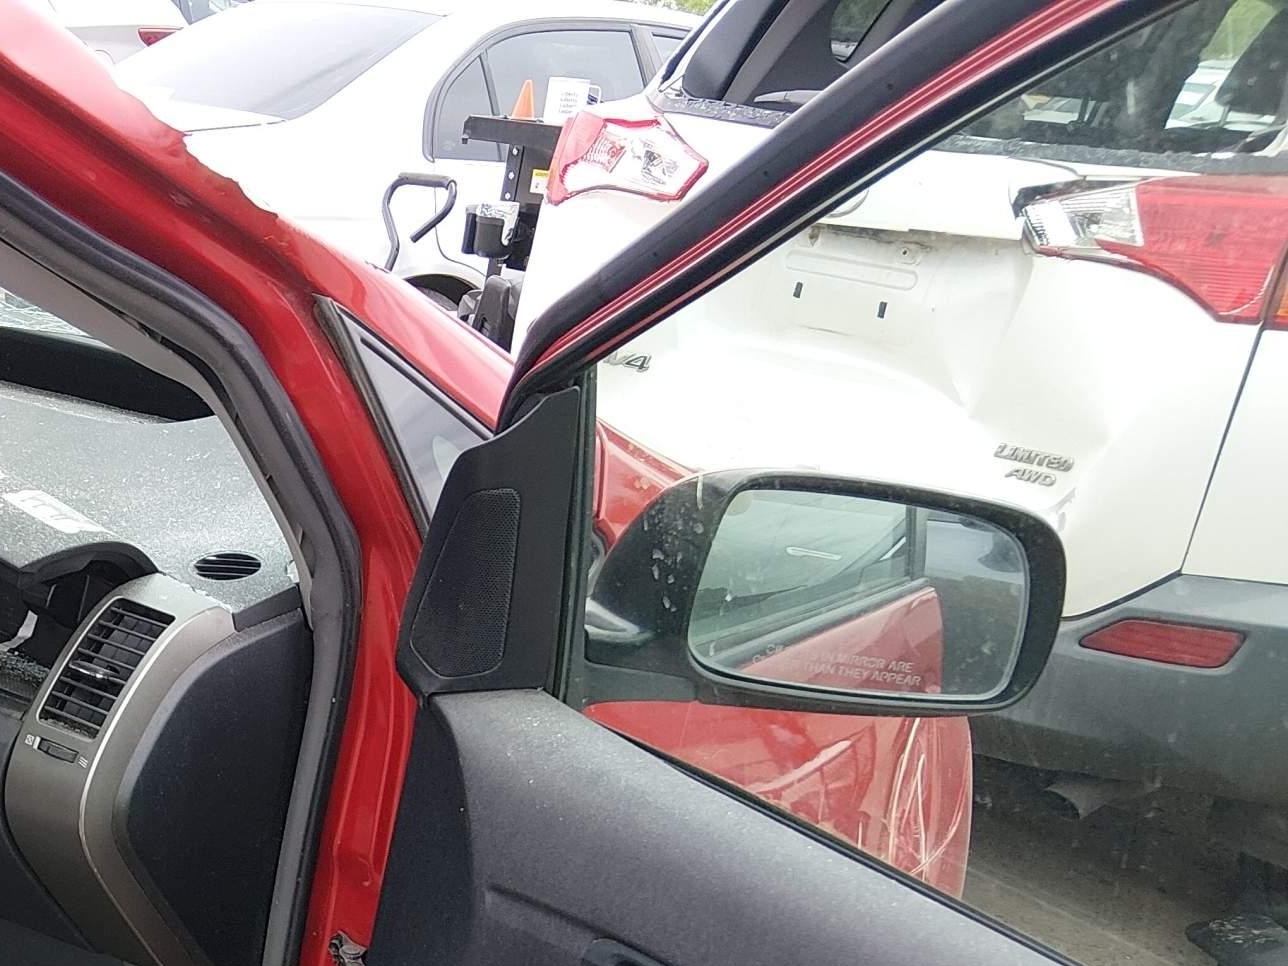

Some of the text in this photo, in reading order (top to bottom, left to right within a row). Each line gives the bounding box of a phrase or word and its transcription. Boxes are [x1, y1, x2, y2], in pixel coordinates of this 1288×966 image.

[993, 442, 1075, 472] LIMITED
[1004, 468, 1057, 487] AWD
[838, 653, 886, 669] MIRROR
[888, 660, 915, 673] ARE
[838, 665, 871, 679] THEY
[870, 670, 922, 686] APPEAR
